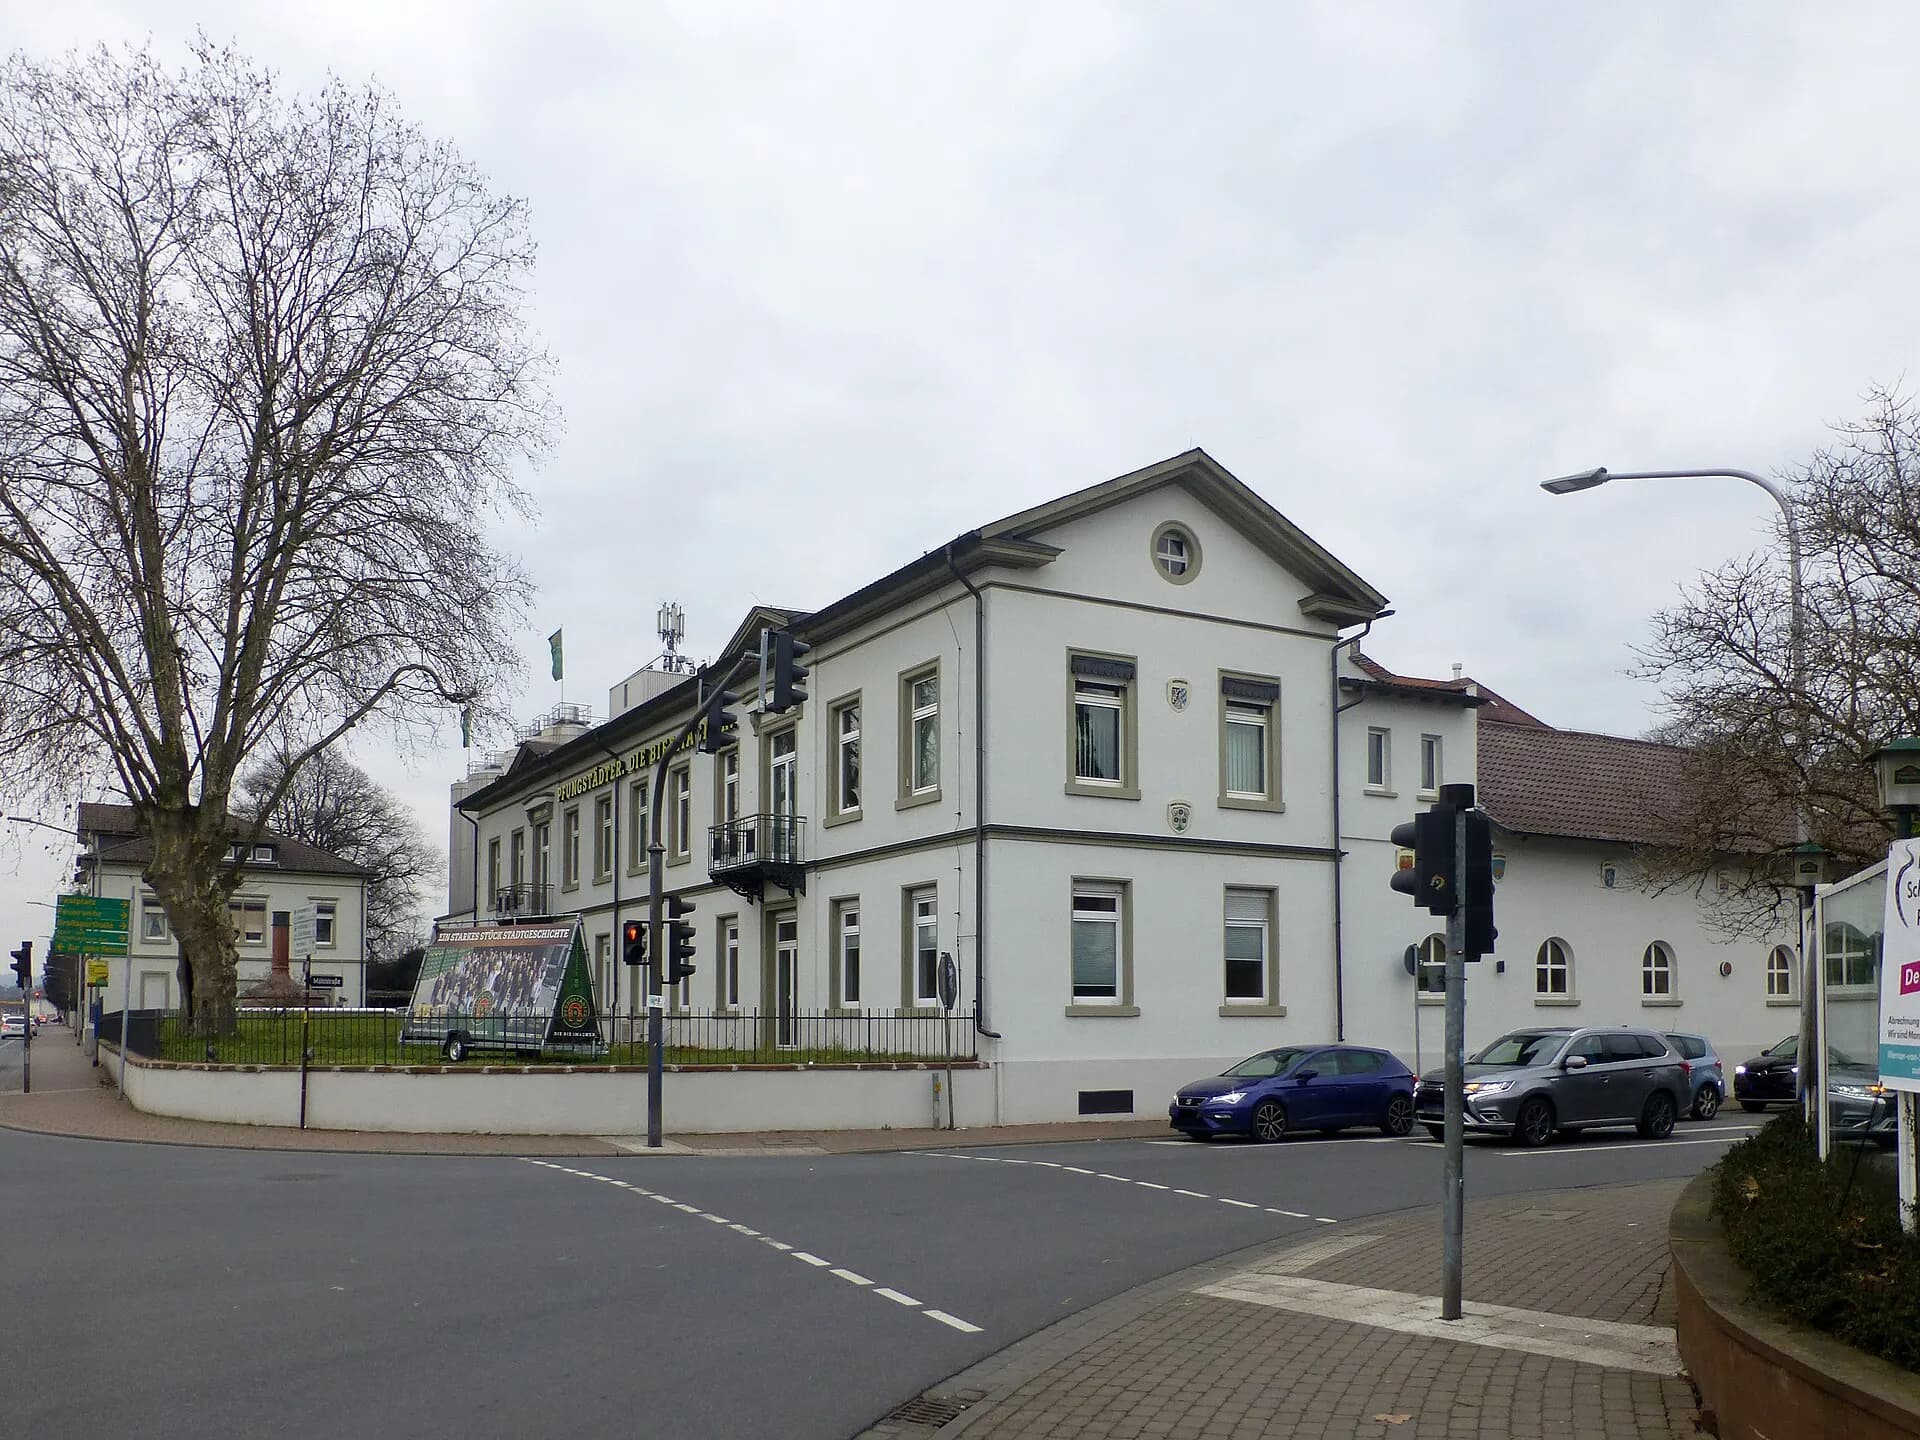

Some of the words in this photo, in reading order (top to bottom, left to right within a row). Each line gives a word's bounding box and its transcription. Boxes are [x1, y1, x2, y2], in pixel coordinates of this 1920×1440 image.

[630, 751, 646, 770] DIE
[438, 933, 451, 942] EIN
[451, 932, 480, 941] STARKES
[480, 930, 502, 940] STÜCK
[503, 928, 570, 939] STADTGESCHICHTE
[1888, 1015, 1920, 1028] Abrechnung
